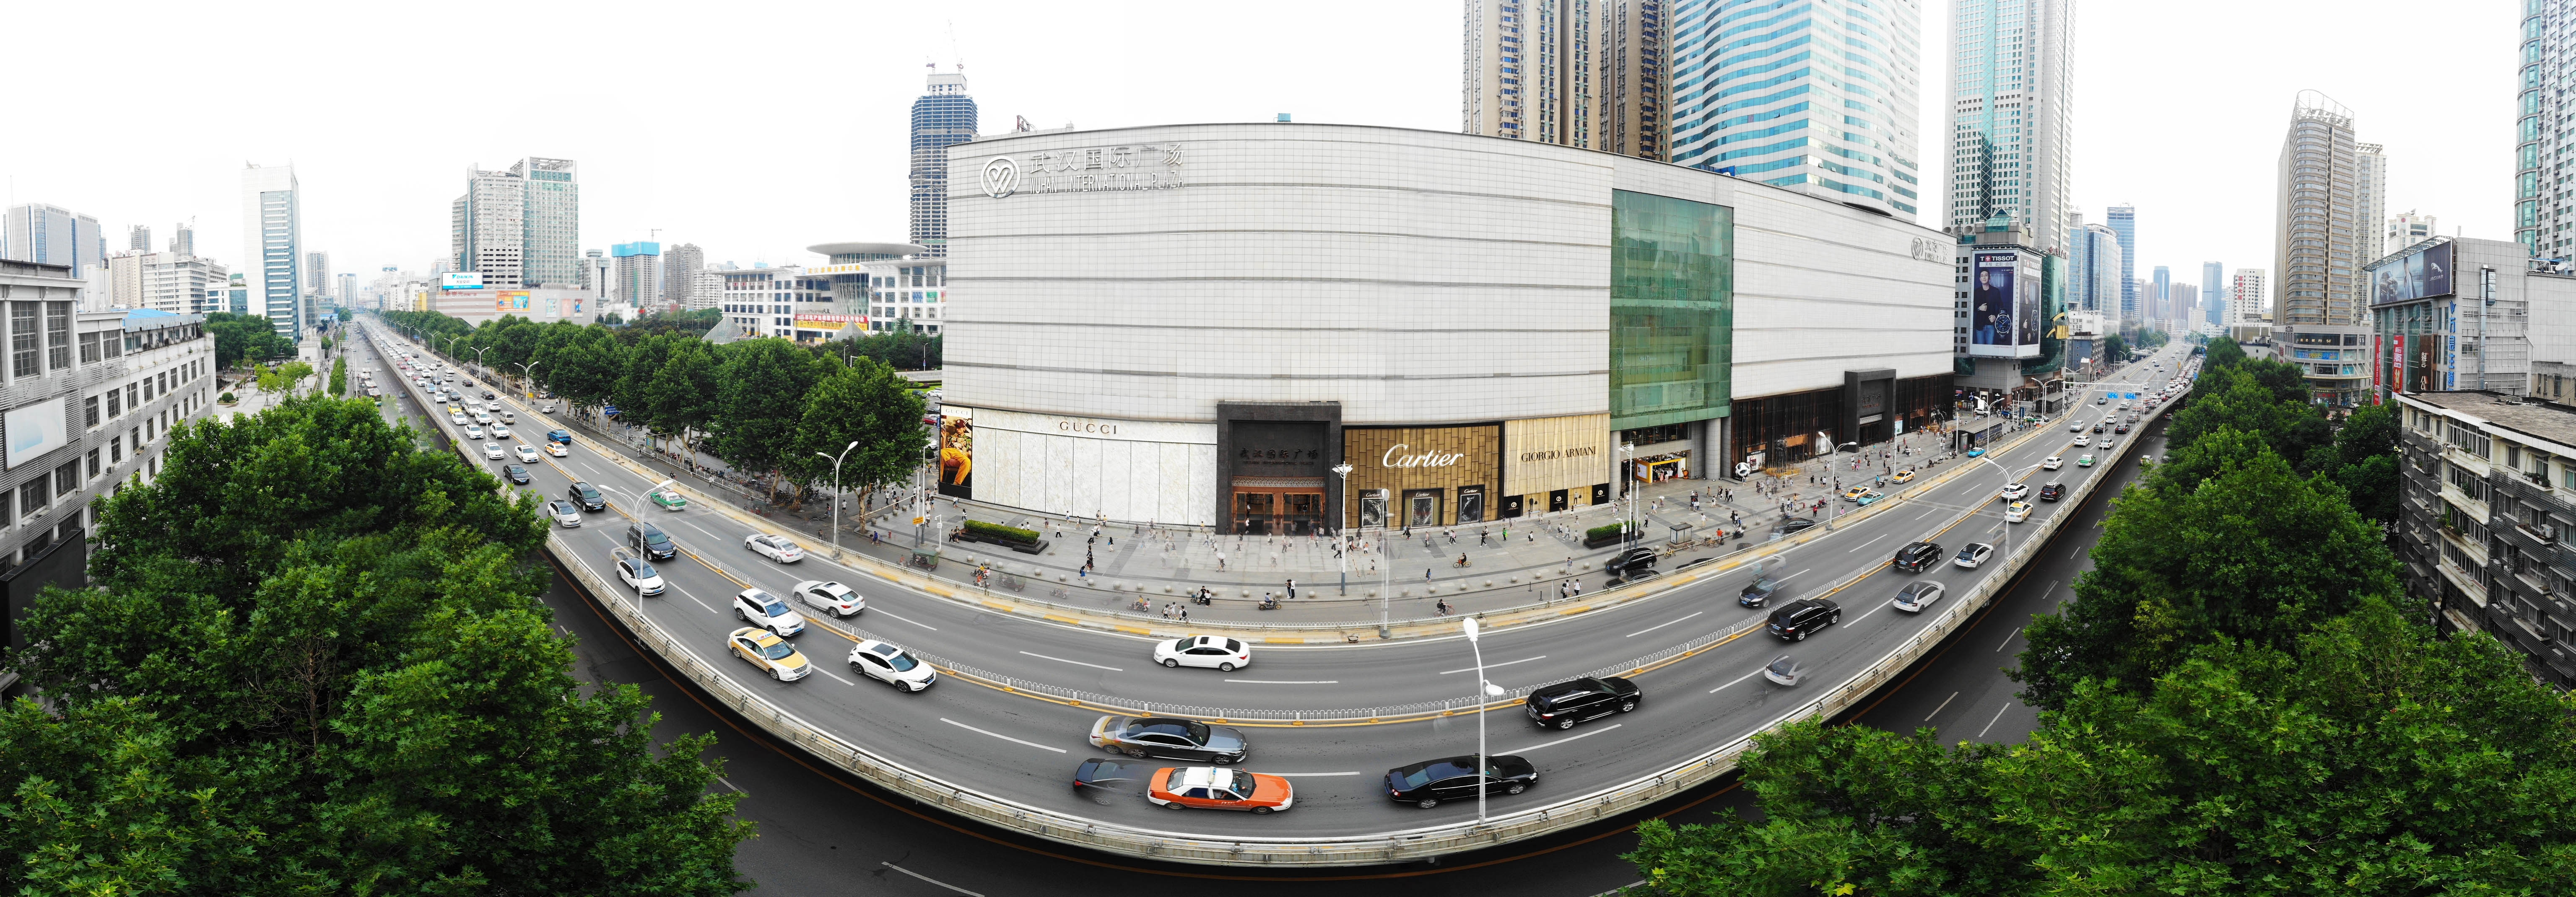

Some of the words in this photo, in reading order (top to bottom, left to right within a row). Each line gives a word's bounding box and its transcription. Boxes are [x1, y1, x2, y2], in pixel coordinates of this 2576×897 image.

[1030, 143, 1184, 174] 武汉国际广场
[1030, 176, 1057, 194] WUHAN
[1065, 173, 1148, 192] INTERNATIONAL
[1151, 170, 1184, 190] PLAZA
[2030, 261, 2041, 270] TISSOT
[1060, 421, 1117, 434] GUCCI
[1383, 443, 1464, 468] Cartier
[1521, 450, 1560, 462] GIORGIO
[1563, 446, 1597, 458] ARMANI
